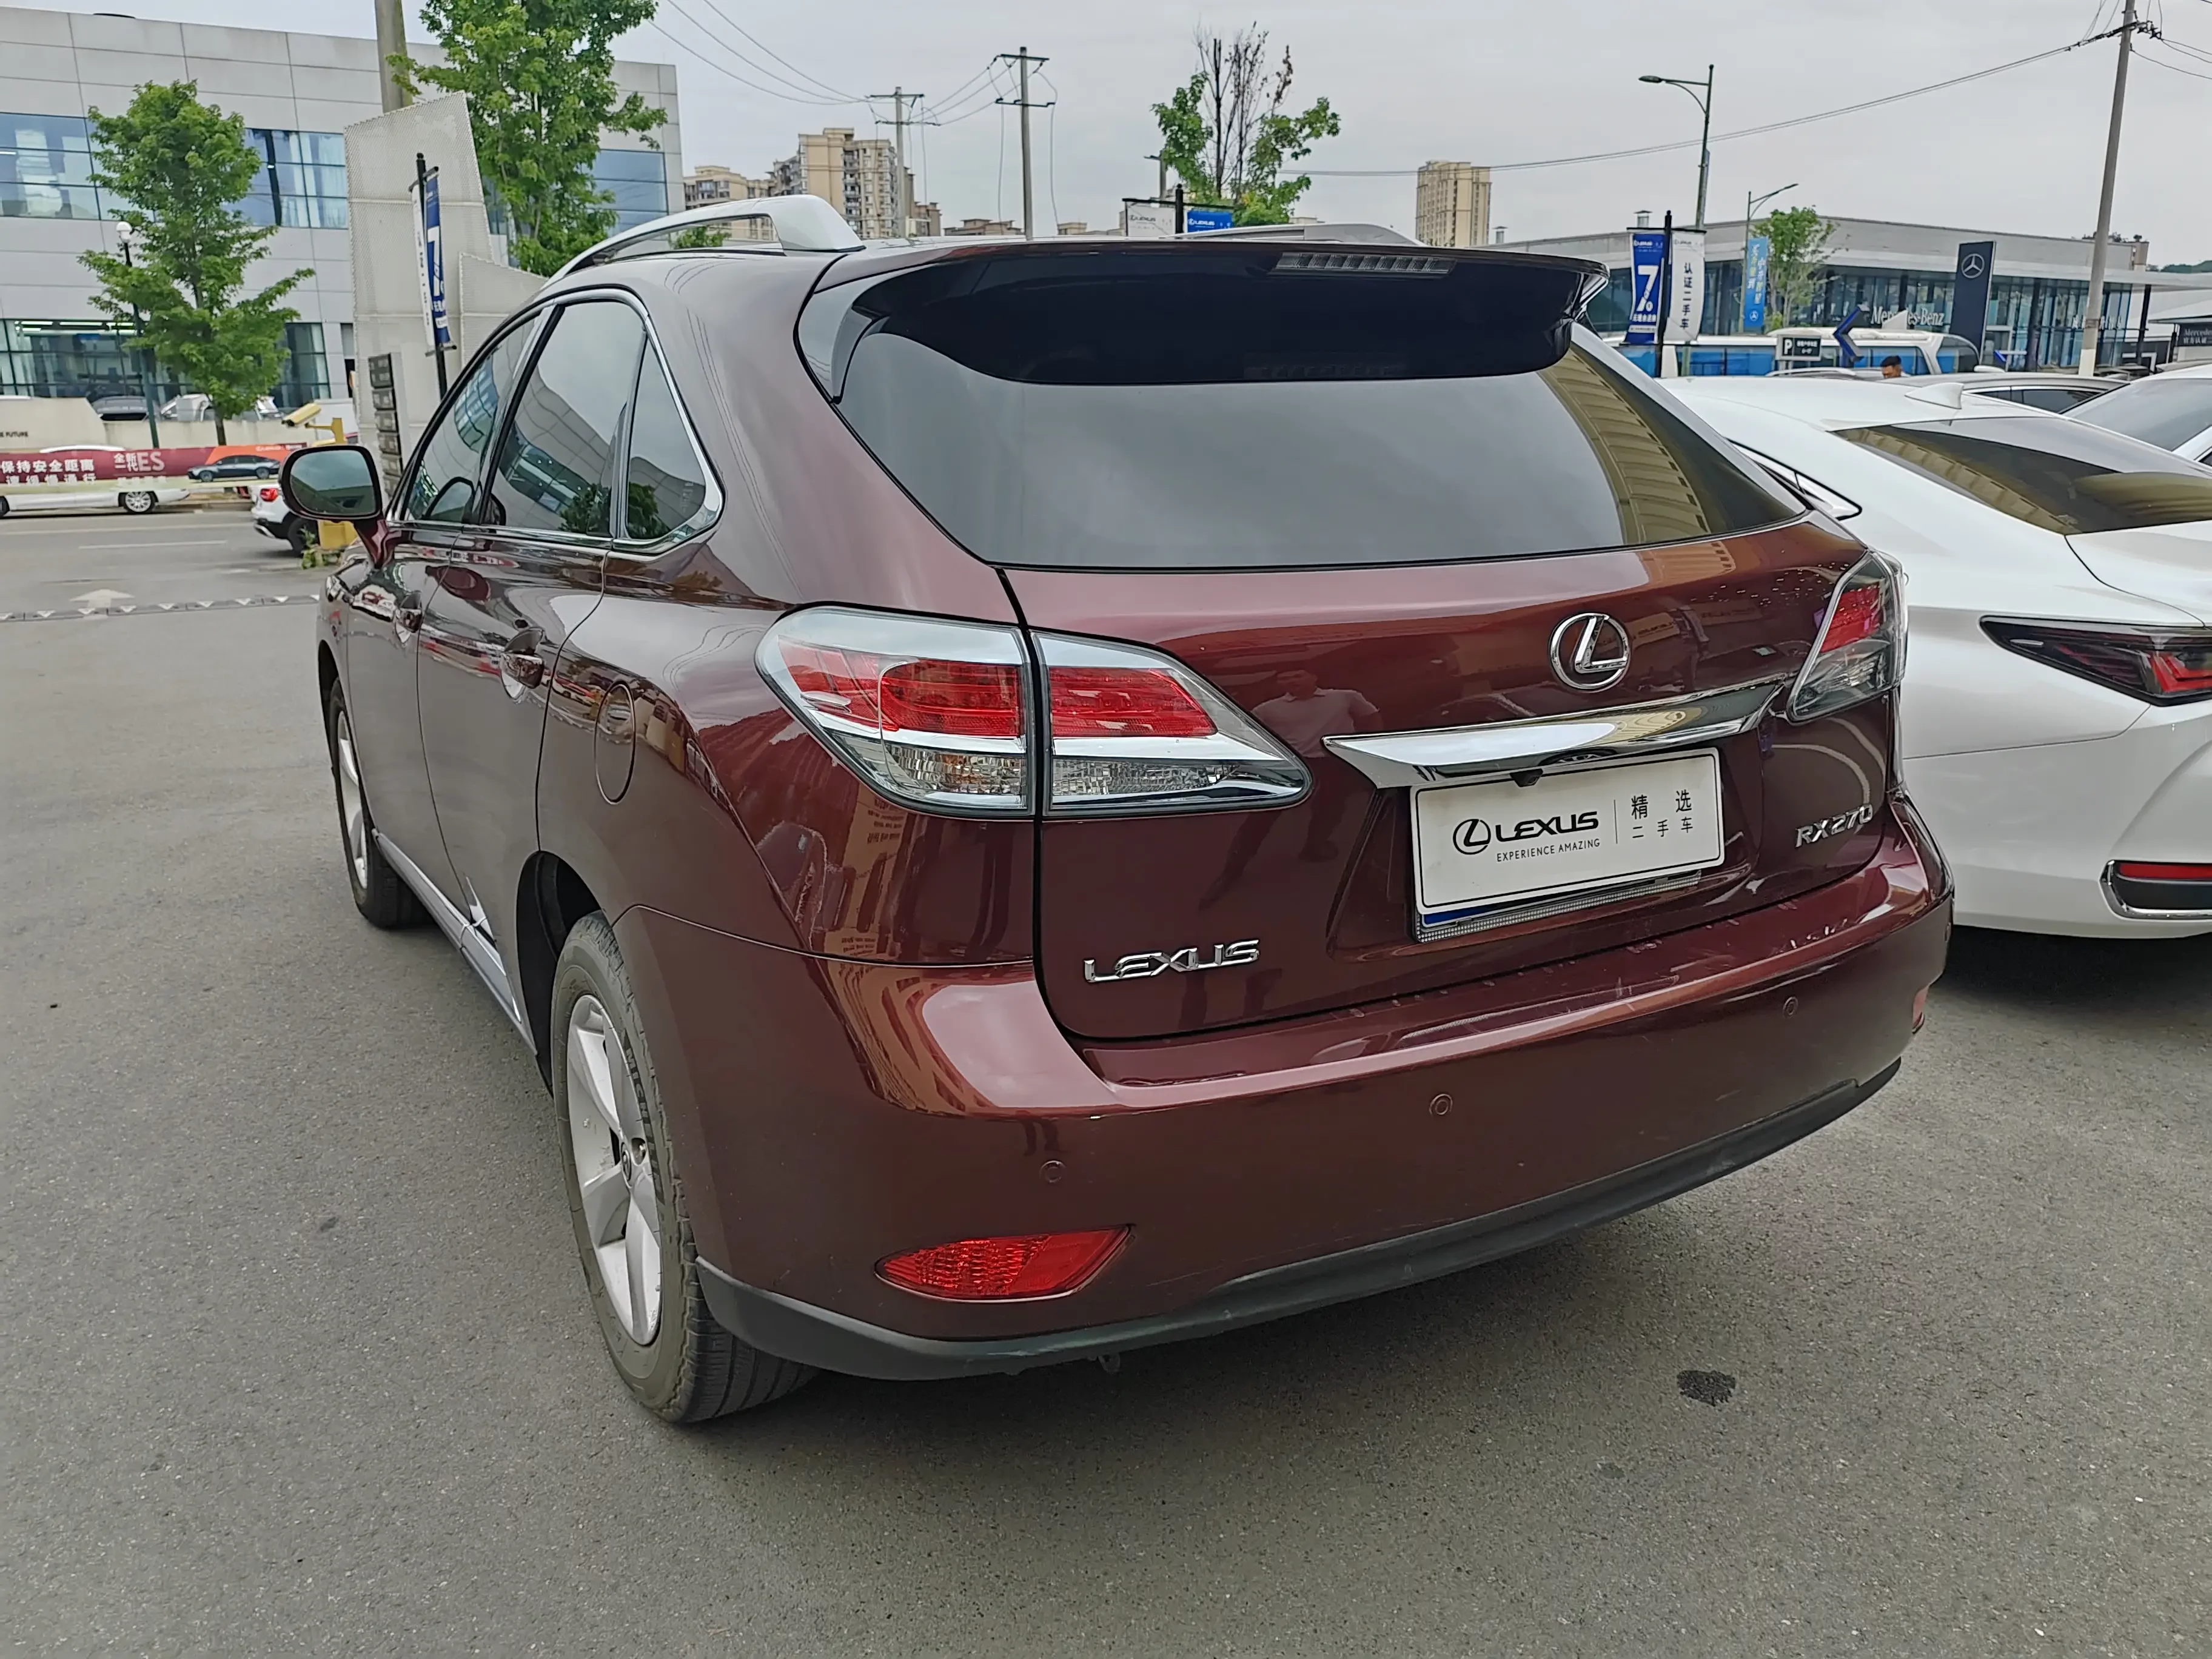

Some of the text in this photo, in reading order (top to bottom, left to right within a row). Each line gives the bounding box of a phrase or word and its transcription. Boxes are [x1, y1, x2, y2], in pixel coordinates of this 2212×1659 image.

[1680, 262, 1693, 329] 认证二手车
[1871, 306, 1945, 326] Meres-Benz
[1784, 339, 1792, 355] P
[1, 459, 95, 474] 保持安全距离
[136, 451, 165, 472] ES
[1631, 789, 1692, 820] 精选
[1495, 811, 1599, 842] LEXUS
[1632, 817, 1693, 838] 二手车
[1496, 839, 1600, 862] EXPERIENCE AMAZING
[1084, 939, 1259, 983] LEXUS
